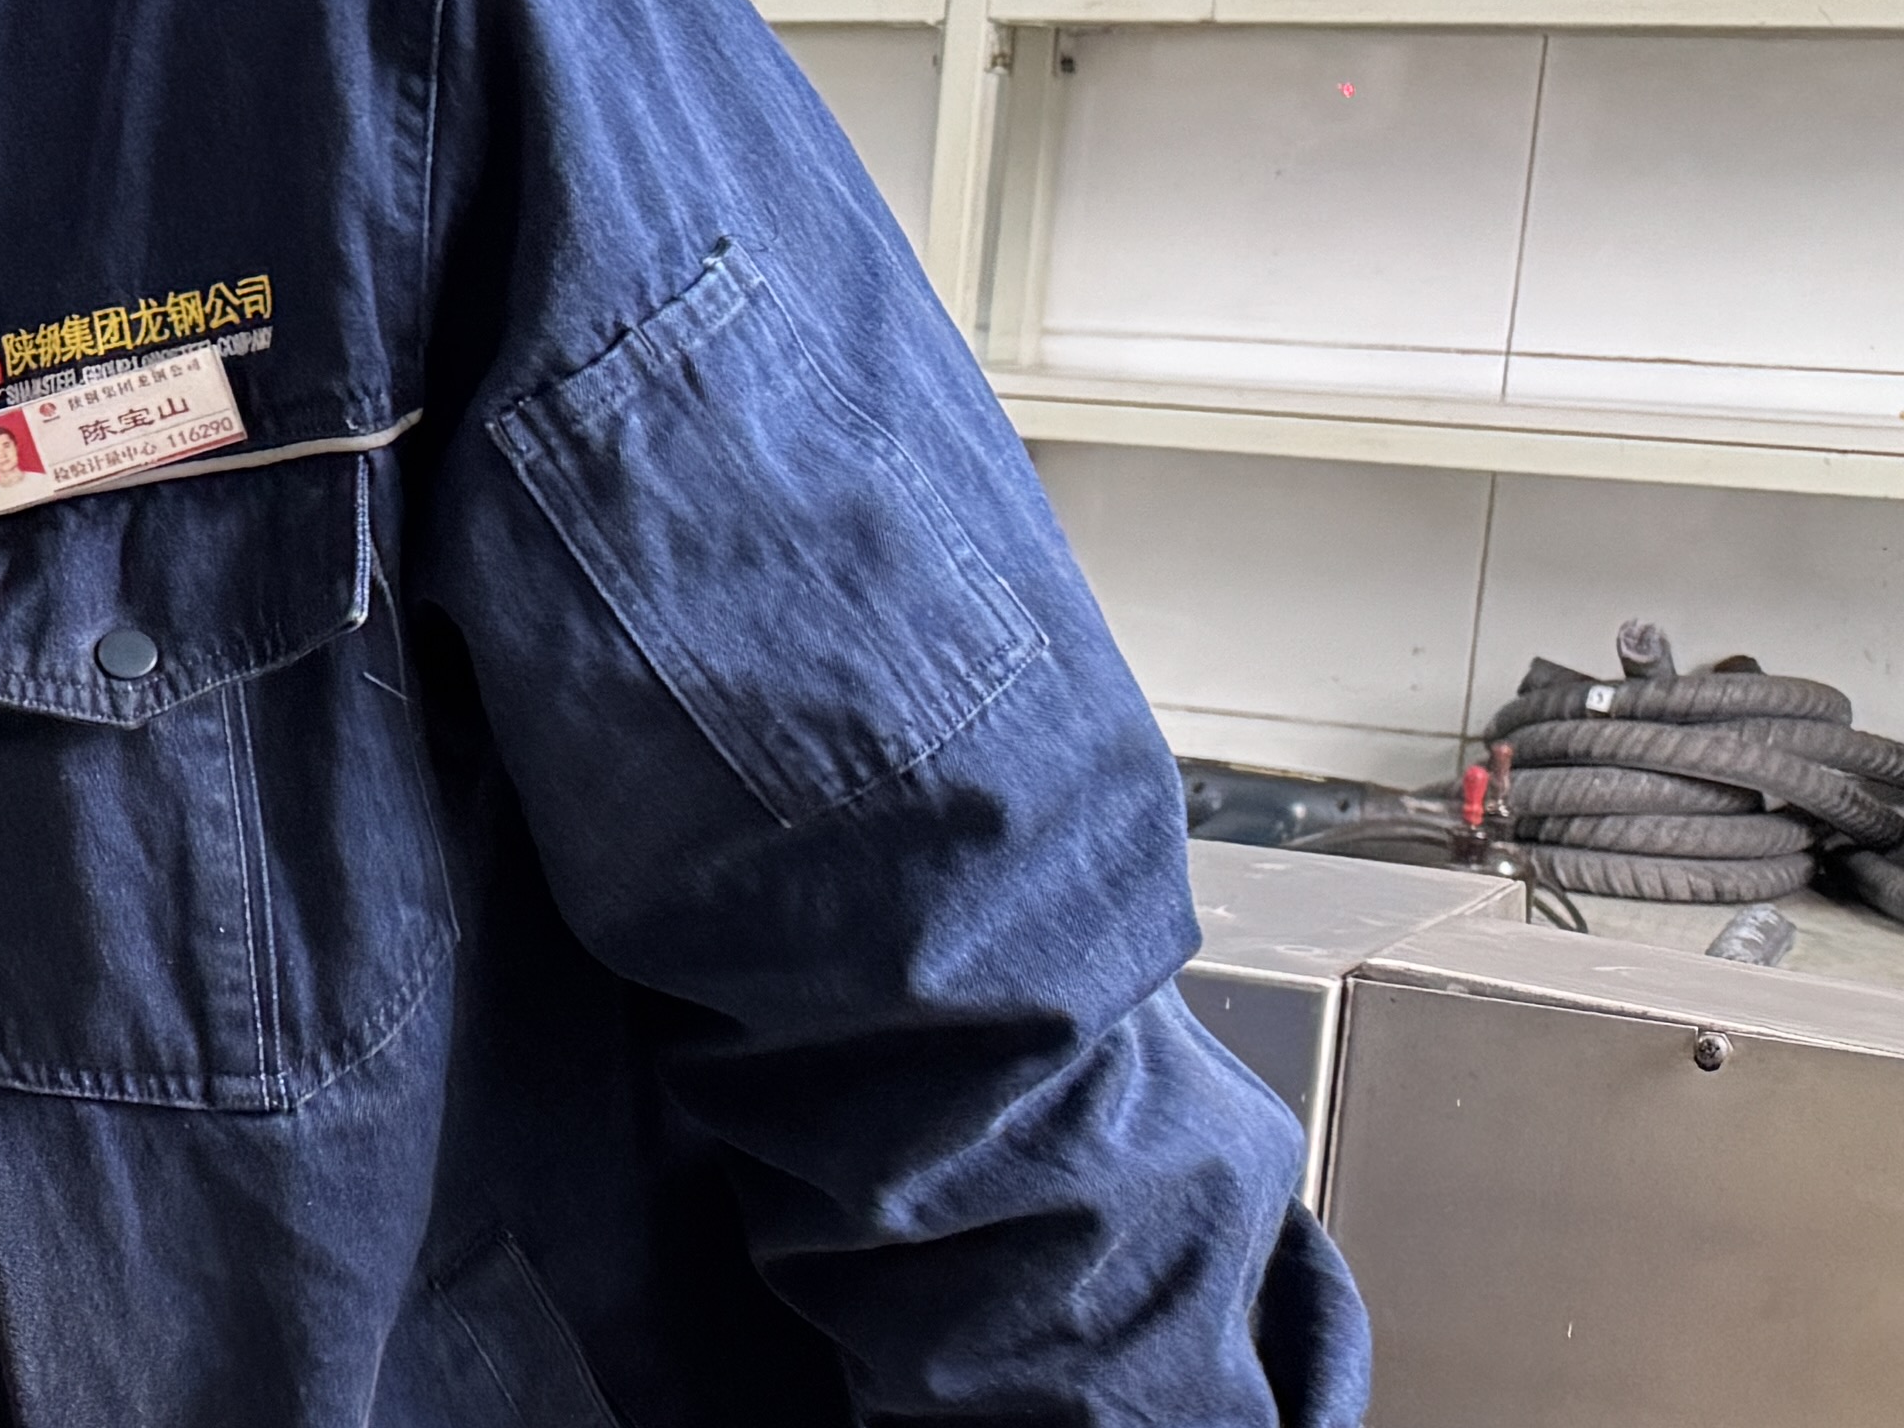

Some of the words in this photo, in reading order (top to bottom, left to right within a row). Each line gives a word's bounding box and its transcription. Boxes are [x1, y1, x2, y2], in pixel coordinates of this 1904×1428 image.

[1, 274, 273, 376] 陕钢集团龙钢公司
[53, 441, 158, 484] 检验计量中心
[166, 416, 234, 449] 116290
[78, 396, 190, 446] 陈宝山
